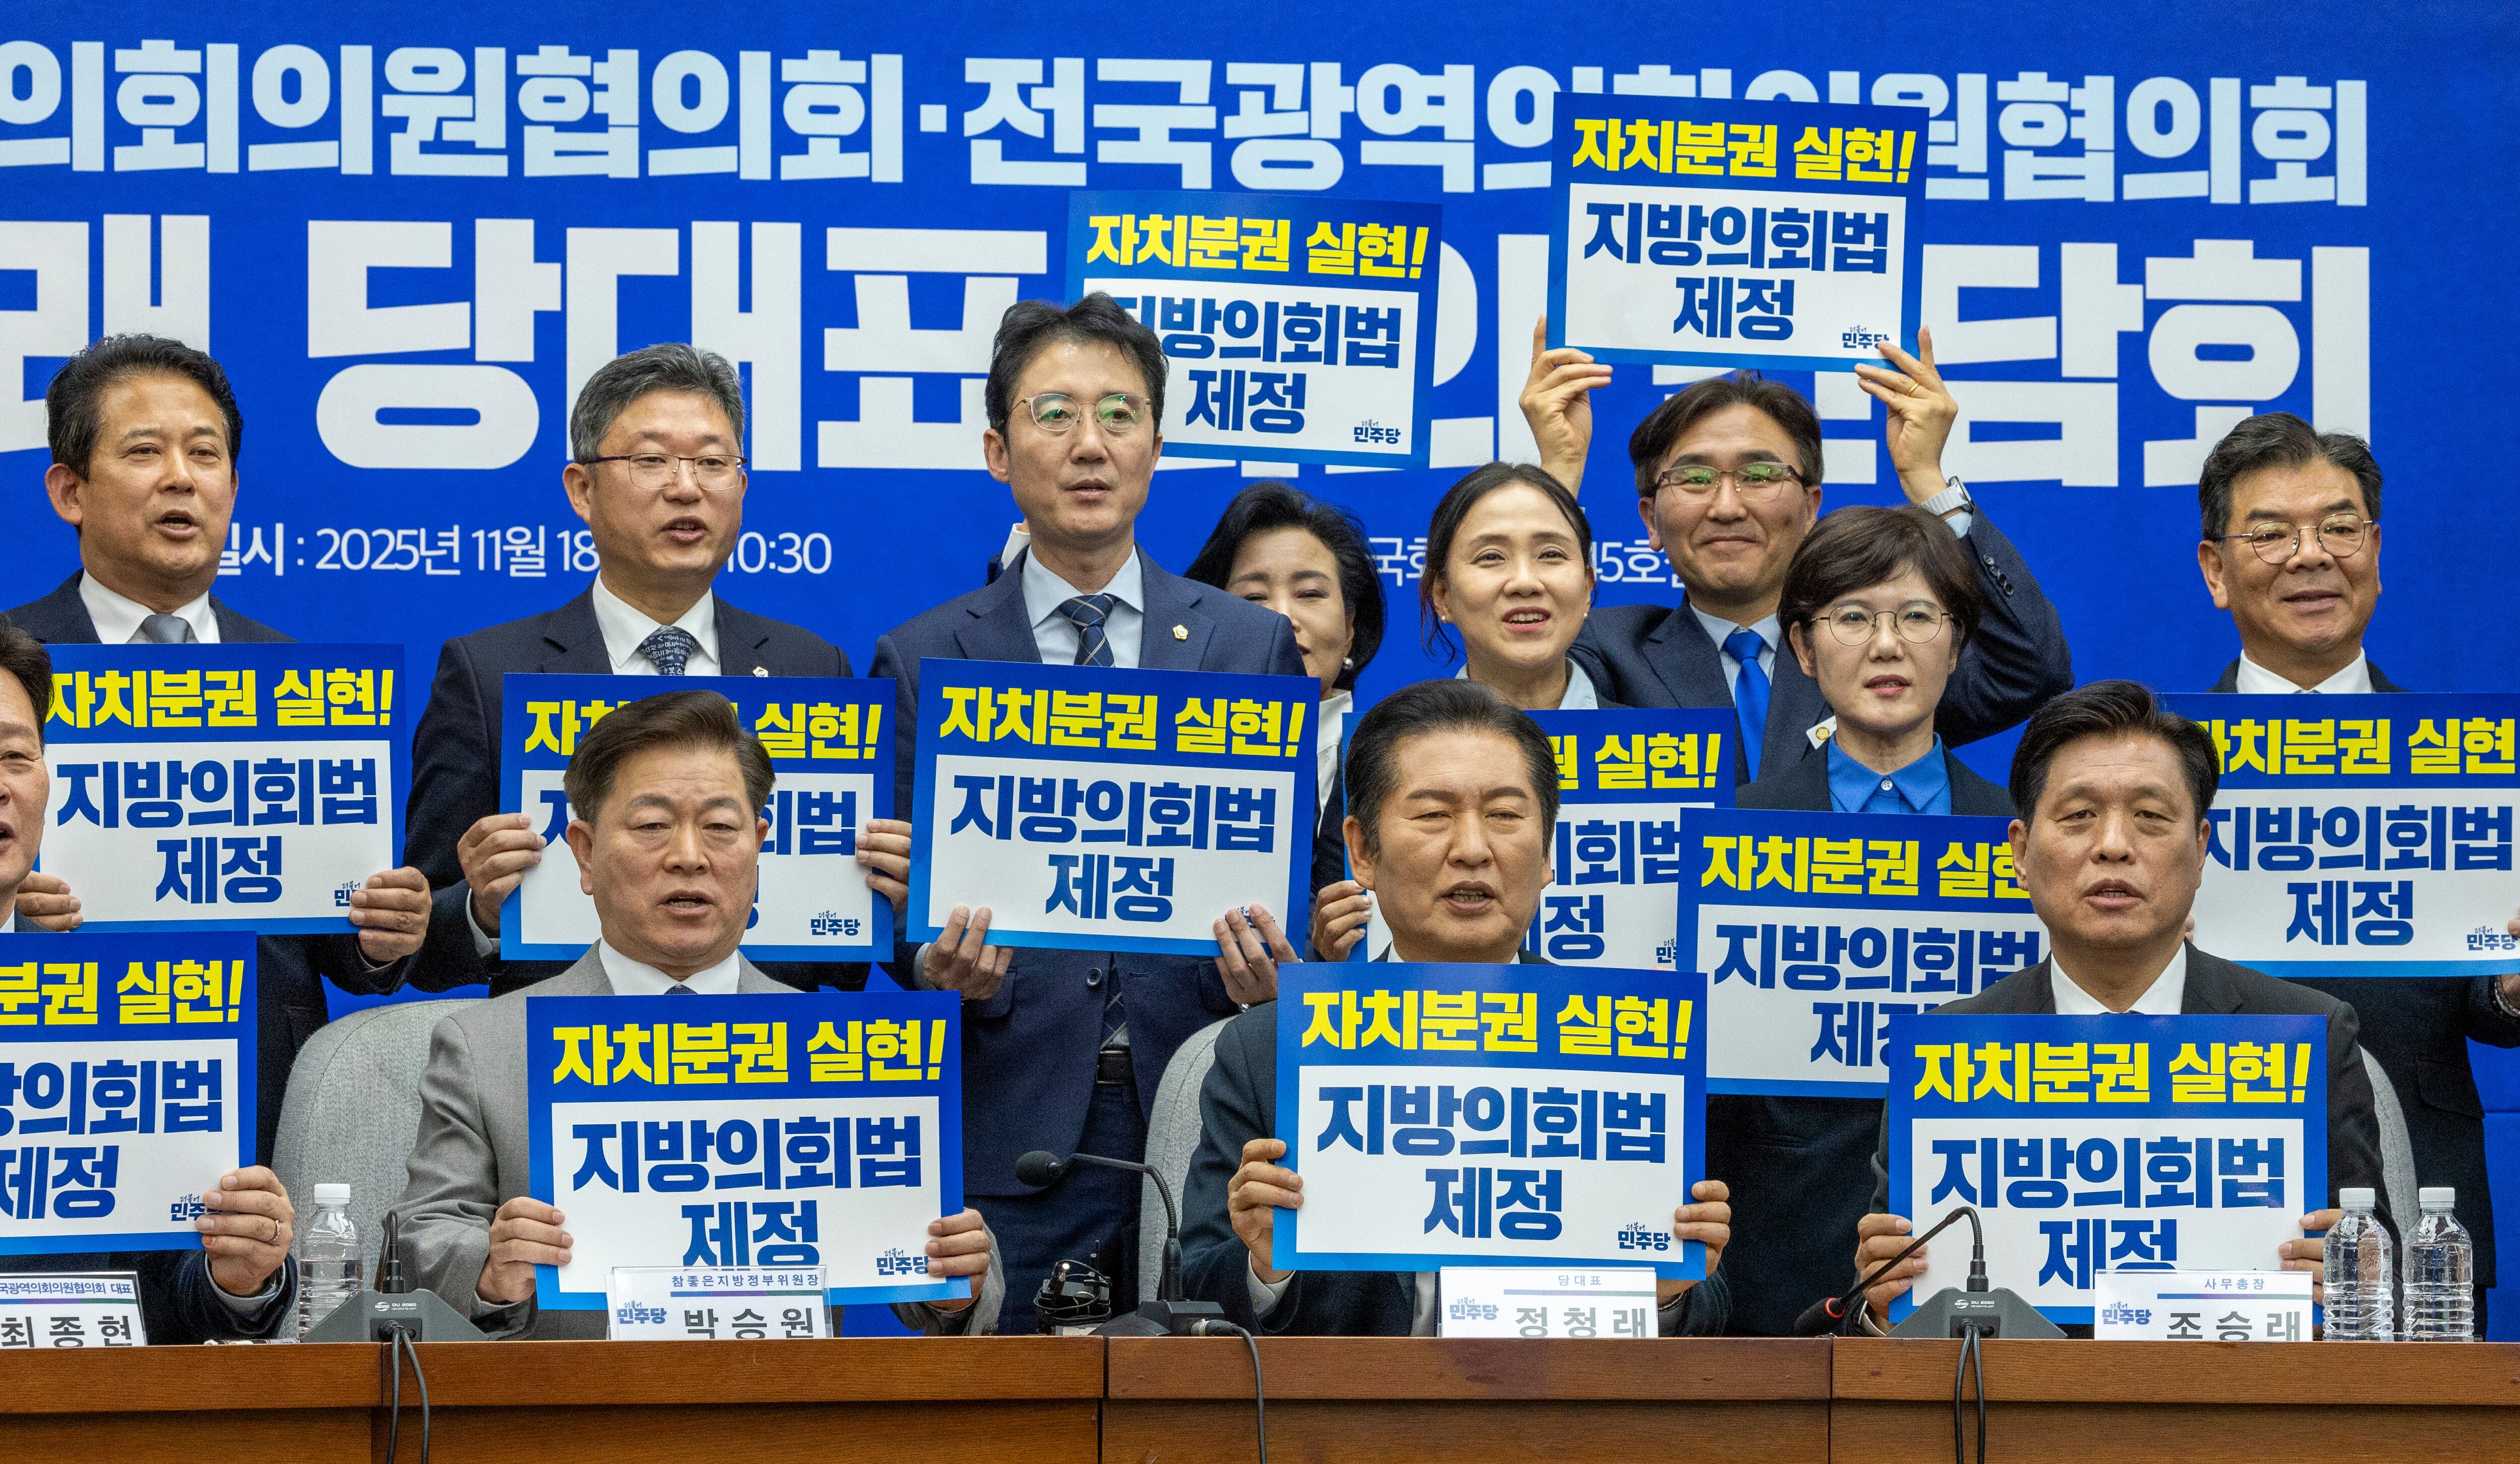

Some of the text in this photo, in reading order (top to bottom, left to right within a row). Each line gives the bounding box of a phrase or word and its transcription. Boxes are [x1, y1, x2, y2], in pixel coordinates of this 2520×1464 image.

[1573, 119, 1916, 182] 자치분권 실현!
[1089, 216, 1428, 278] 자치분권 실현!
[1585, 203, 1888, 274] 지방의회법
[1673, 277, 1794, 340] 제정
[1186, 370, 1306, 434] 제정
[1359, 419, 1378, 429] 더불어
[1354, 425, 1401, 444] 민주당
[317, 525, 460, 574] 2025년
[472, 526, 546, 576] 11월
[45, 668, 393, 727] 자치분권 실현!
[940, 687, 1305, 757] 자치분권 실현!
[756, 703, 881, 759] 실현!
[2409, 718, 2514, 773] 실현
[1596, 734, 1720, 788] 실현!
[57, 758, 377, 828] 지방의회법
[951, 775, 1276, 853] 지방의회법
[1702, 836, 1919, 895] 자치분권
[2204, 805, 2512, 871] 지방의회법
[156, 836, 282, 903] 제정
[342, 881, 360, 889] 더불어
[1046, 854, 1174, 922] 제정
[811, 916, 860, 936] 민주당
[818, 910, 836, 920] 더불어
[1523, 895, 1605, 959] 정
[2287, 881, 2414, 945] 제정
[2475, 926, 2492, 934] 더불어
[1714, 924, 2039, 995] 지방의회법
[2467, 934, 2516, 950] 민주당
[117, 960, 243, 1023] 실현!
[554, 1020, 946, 1085] 자치분권 실현!
[1303, 991, 1692, 1059] 자치분권 실현!
[1811, 1001, 1939, 1067] 제
[1915, 1042, 2310, 1102] 자치분권 실현!
[1318, 1085, 1665, 1163] 지방의회법
[573, 1116, 921, 1193] 지방의회법
[1932, 1136, 2284, 1208] 지방의회법
[171, 1203, 219, 1221] 민주
[179, 1193, 200, 1204] 더불어
[1424, 1168, 1562, 1240] 제정
[681, 1200, 820, 1271] 제정
[883, 1248, 904, 1259] 더불어
[1618, 1230, 1670, 1251] 민주당
[1624, 1222, 1646, 1233] 더불어
[111, 1284, 133, 1294] 대표
[672, 1274, 818, 1288] 참좋은지방정부위원장
[877, 1257, 928, 1275] 민주당
[1558, 1274, 1602, 1286] 당대표
[2204, 1278, 2264, 1291] 사무총장
[1, 1316, 132, 1348] 최종현
[616, 1306, 667, 1325] 민주당
[684, 1308, 813, 1339] 박승원
[1450, 1303, 1498, 1320] 민주당
[1516, 1307, 1646, 1338] 정청래
[2102, 1308, 2152, 1326] 민주당
[2167, 1311, 2300, 1341] 조승래
